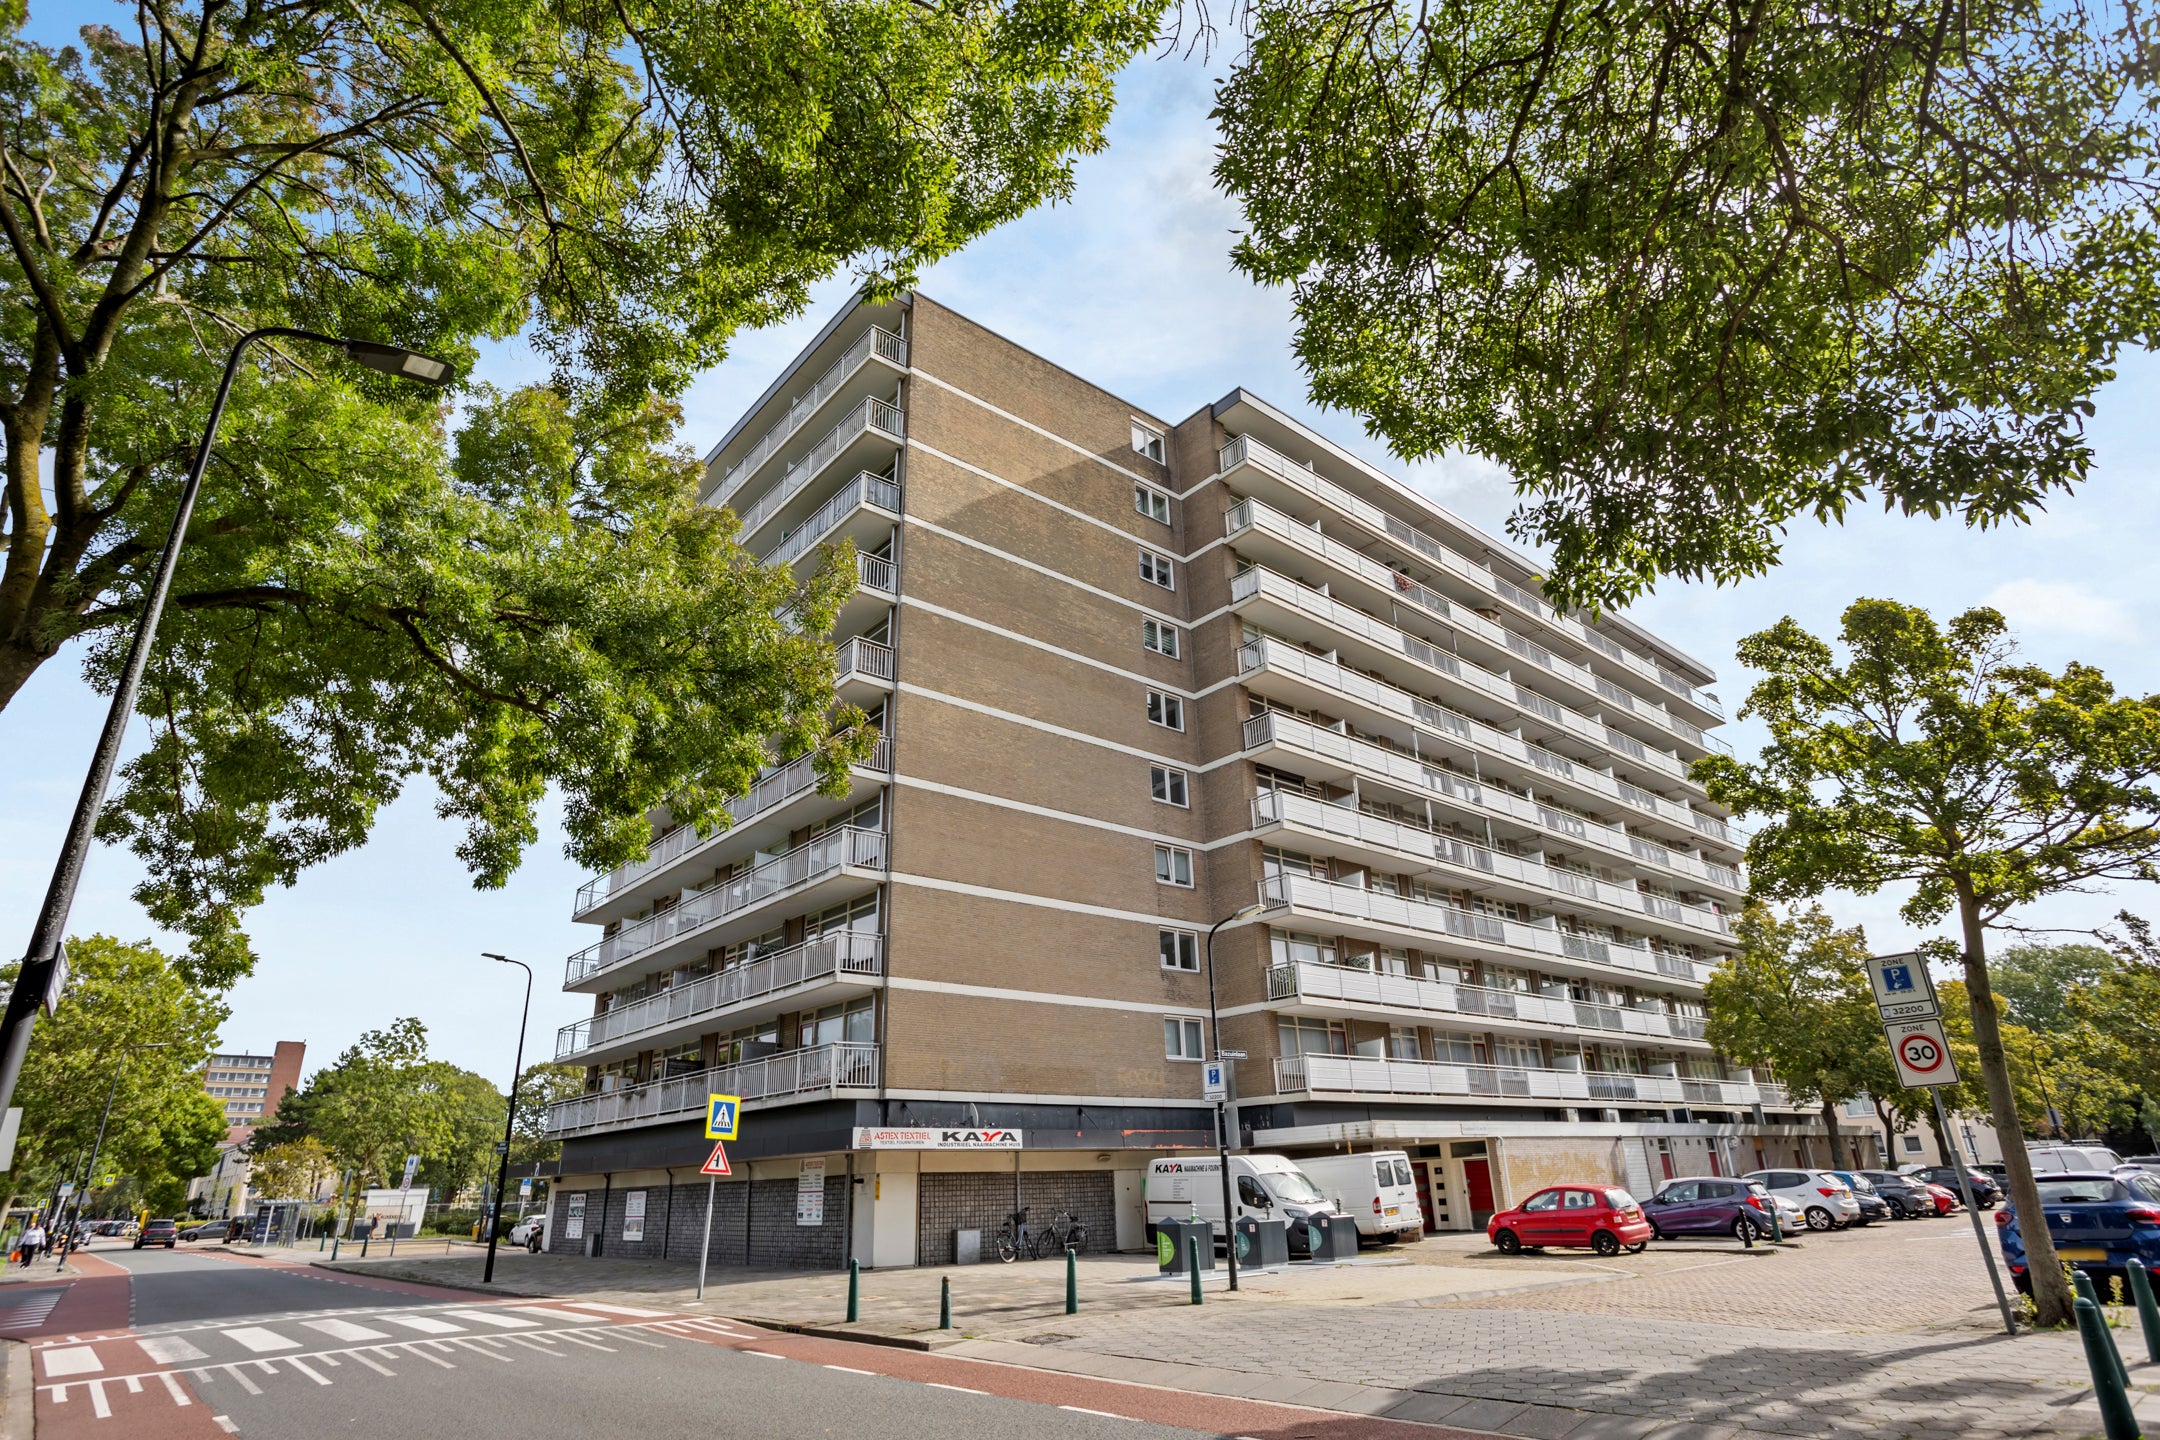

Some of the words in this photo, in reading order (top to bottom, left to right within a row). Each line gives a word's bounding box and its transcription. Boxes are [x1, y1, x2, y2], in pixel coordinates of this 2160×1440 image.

[1881, 957, 1905, 967] ZONE
[1890, 968, 1900, 980] P
[1892, 1005, 1924, 1015] 32200
[1901, 1024, 1926, 1033] ZONE
[1907, 1045, 1936, 1061] 30
[874, 1131, 899, 1140] ASTEX
[900, 1131, 931, 1140] TEXTIEL
[942, 1131, 1017, 1142] KAYA
[1155, 1163, 1183, 1173] KAYA
